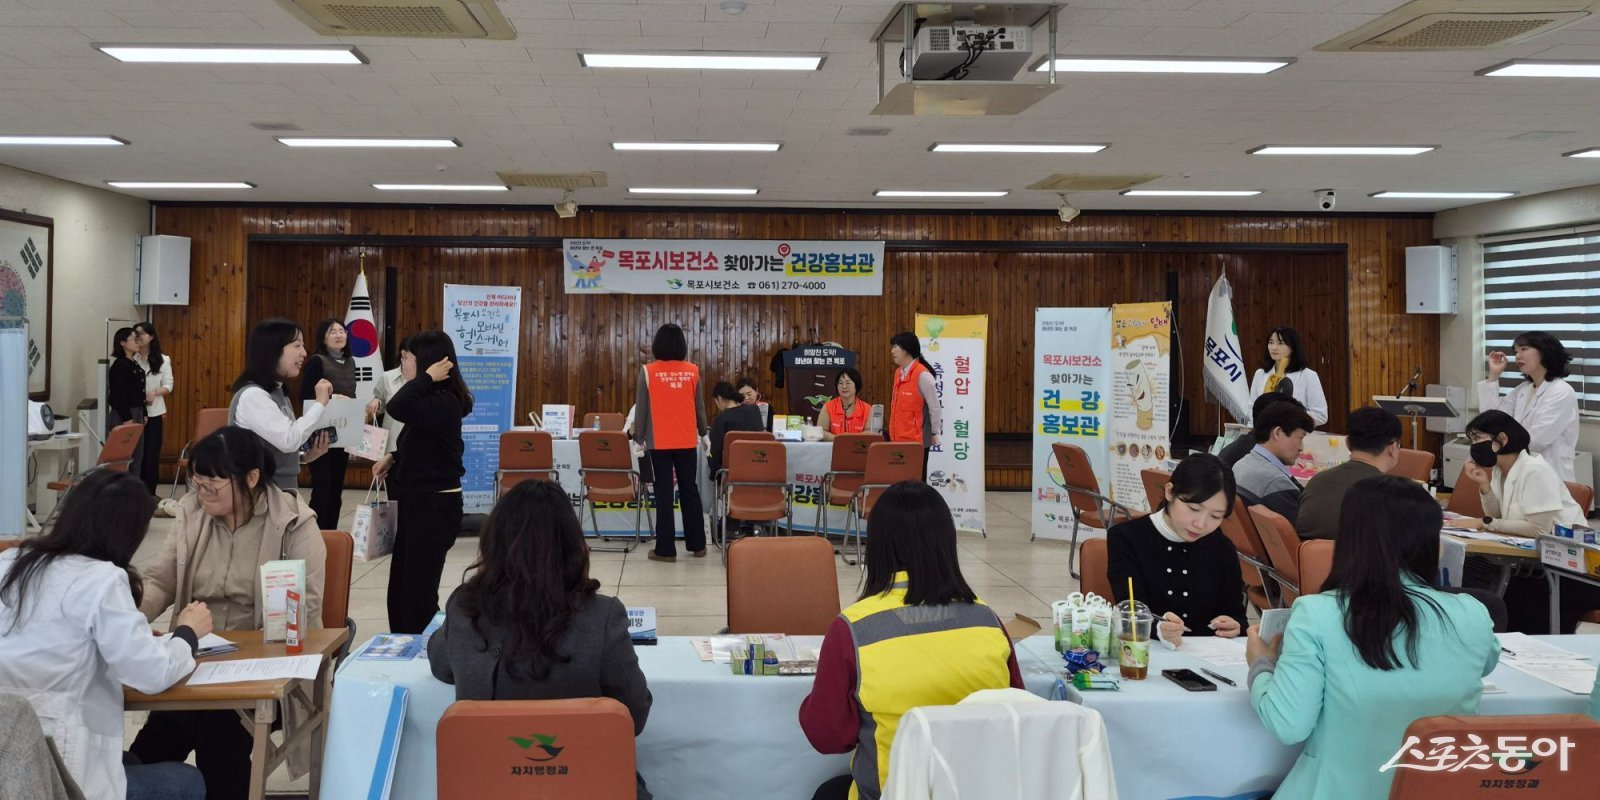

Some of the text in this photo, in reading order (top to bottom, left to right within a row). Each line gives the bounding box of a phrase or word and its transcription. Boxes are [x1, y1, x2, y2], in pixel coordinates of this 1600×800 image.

[618, 250, 875, 273] 목포시보건소 찾아가는 건강홍보관
[687, 280, 826, 290] 목포시보건소 061) 270-4000
[794, 357, 846, 365] 청년이 찾는 큰 목포
[803, 348, 837, 357] 희망찬 도약!
[1042, 354, 1102, 367] 목포시보건소
[1205, 336, 1242, 383] 목포시
[954, 355, 971, 395] 혈압
[1050, 373, 1094, 385] 찾아가는
[1042, 413, 1101, 436] 홍보관
[953, 419, 970, 461] 혈당
